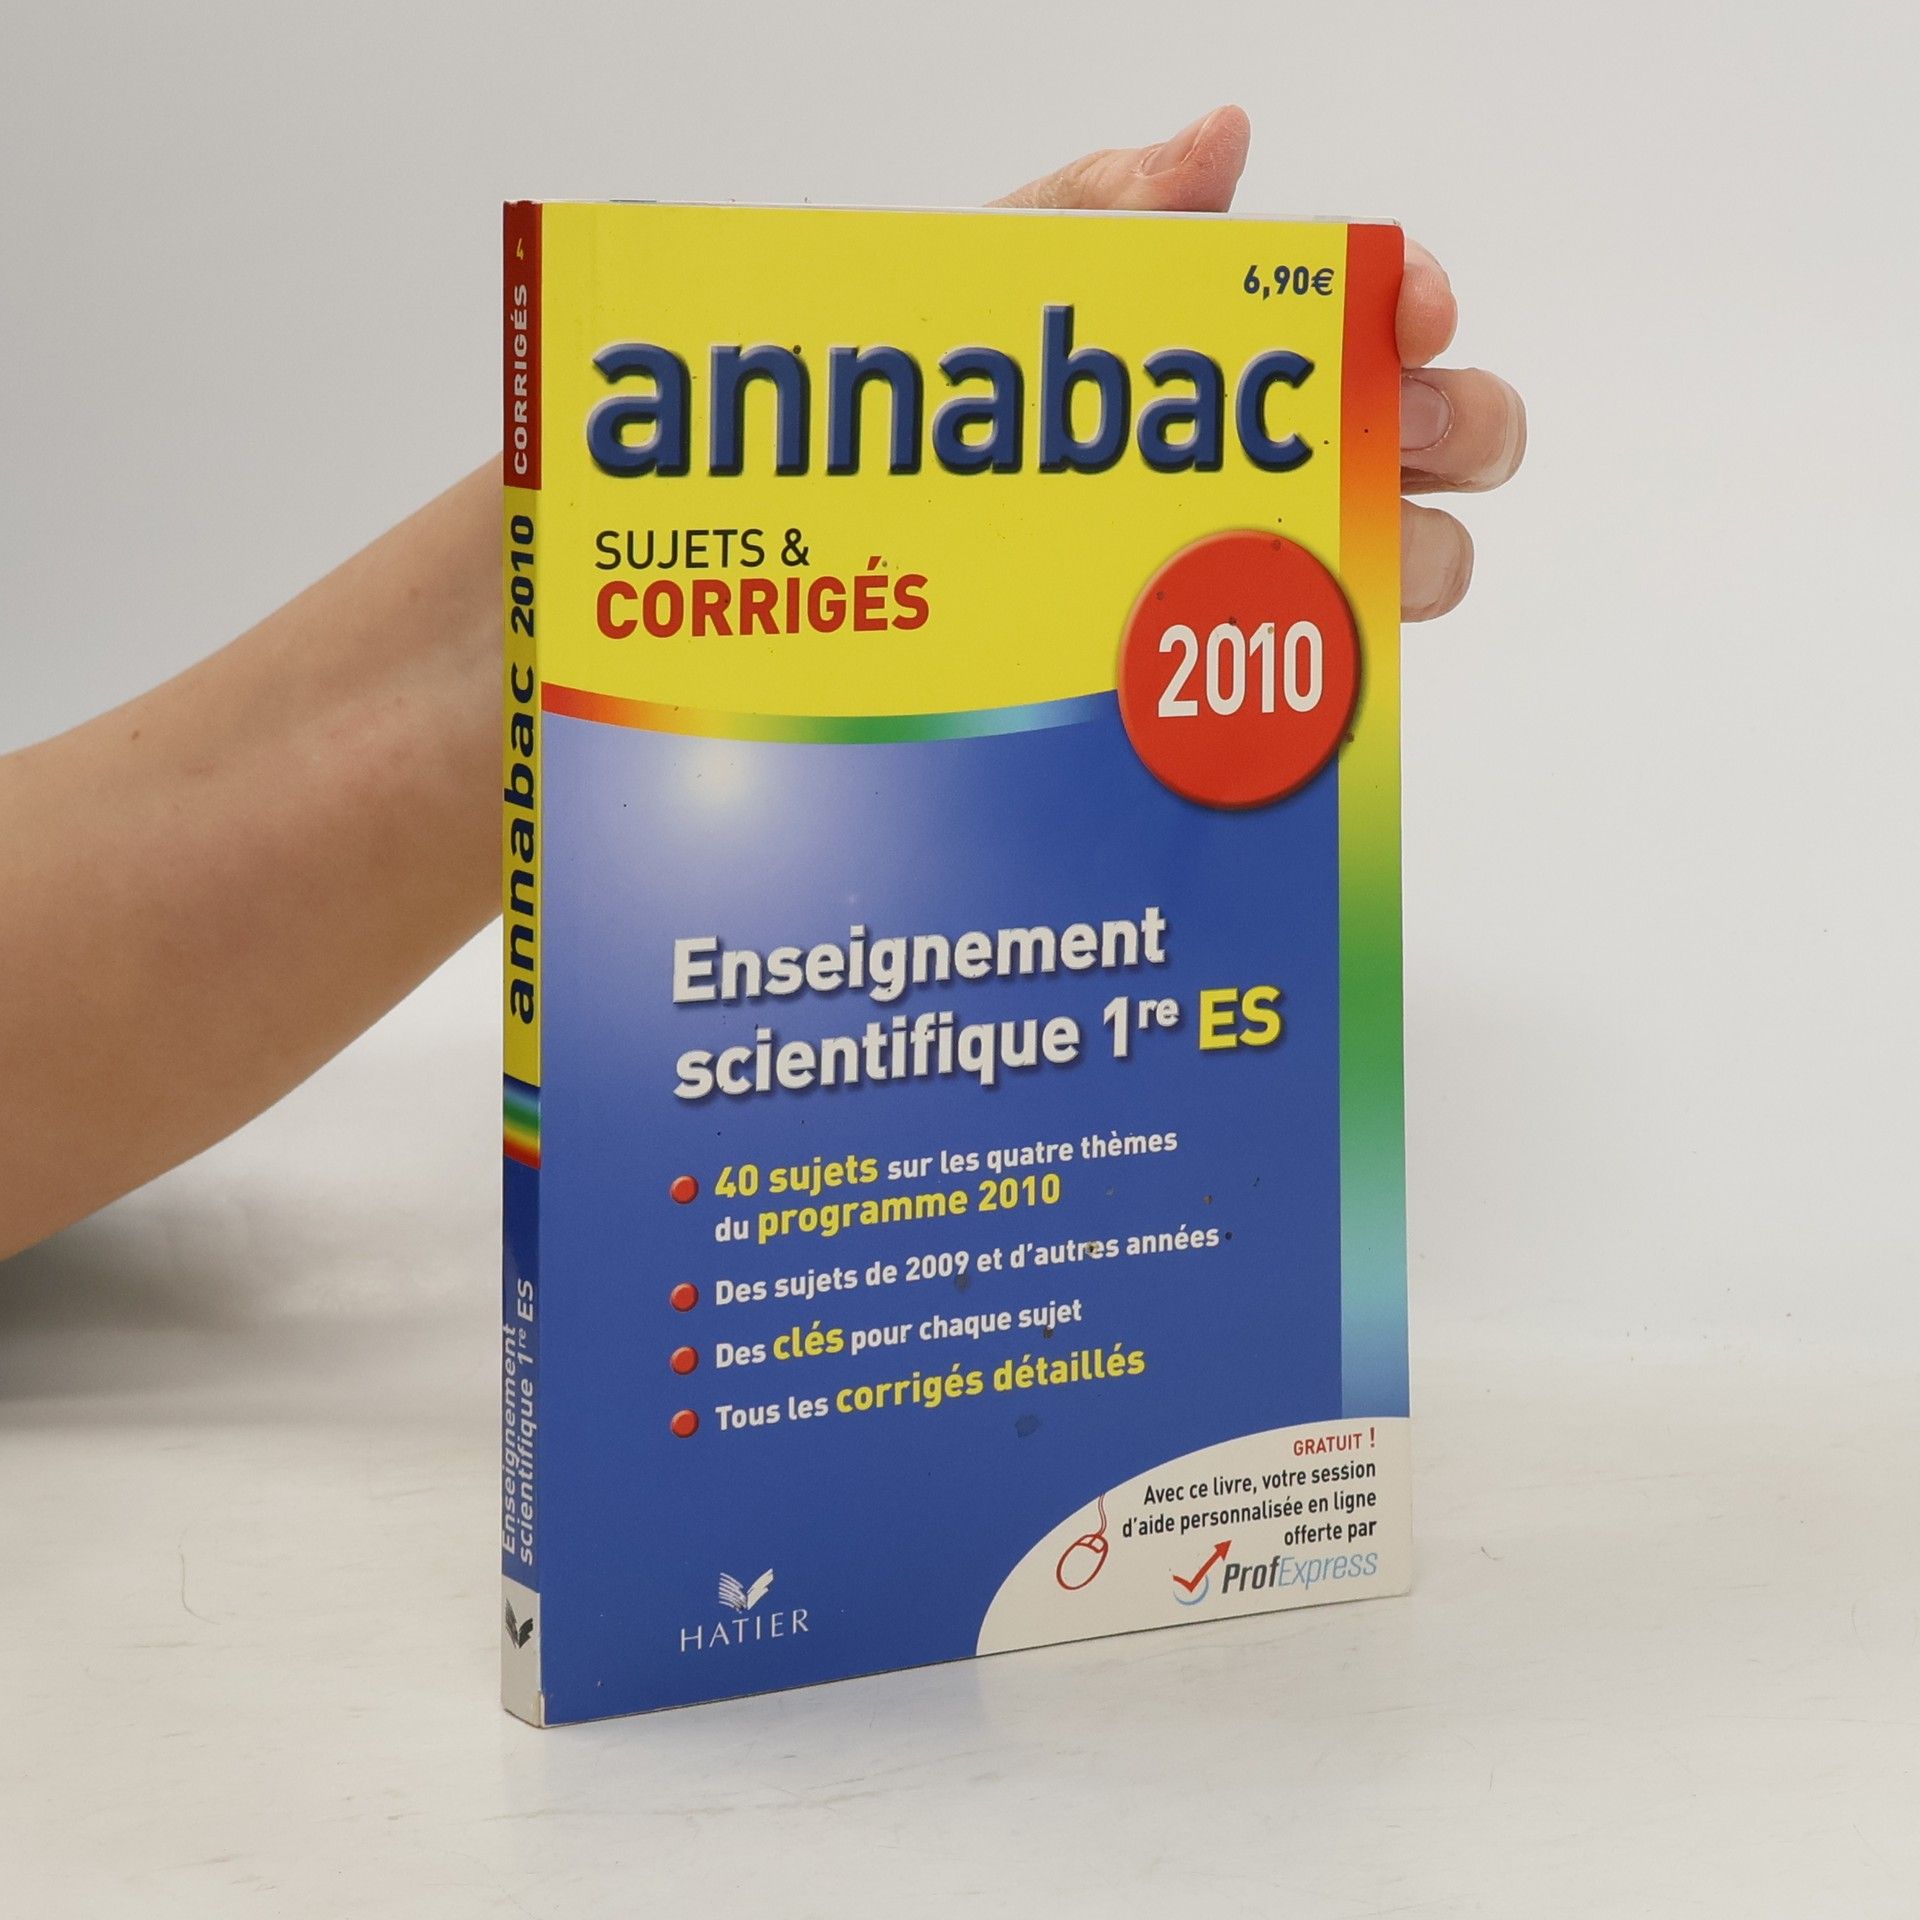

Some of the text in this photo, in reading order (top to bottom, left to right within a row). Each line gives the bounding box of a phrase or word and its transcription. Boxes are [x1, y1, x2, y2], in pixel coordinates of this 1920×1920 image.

[1243, 264, 1335, 300] 6,90€
[510, 283, 528, 475] CORRIGÉS
[587, 304, 1315, 478] annabac
[594, 527, 810, 570] SUJETS &
[595, 556, 931, 640] CORRIGÉS
[1157, 620, 1324, 718] 2010
[503, 514, 535, 1025] annabac 2010
[672, 906, 1167, 1004] Enseignement
[672, 1010, 1080, 1100] scientifique
[1198, 984, 1282, 1051] ES
[714, 1130, 1178, 1199] 40 sujets sur les quatre thèmes
[714, 1172, 1062, 1245] du programme 2010
[517, 1278, 534, 1322] ES
[715, 1280, 767, 1306] Des
[774, 1268, 858, 1301] sujets
[864, 1260, 898, 1287] de
[905, 1250, 970, 1282] 2009
[976, 1248, 1003, 1273] et
[1126, 1223, 1220, 1256] années
[715, 1299, 1082, 1369] Des clés pour chaque sujet
[715, 1342, 1146, 1432] Tous les corrigés détaillés
[502, 1323, 518, 1555] Enseignement
[516, 1378, 537, 1567] scientifique
[1293, 1426, 1376, 1456] GRATUIT !
[1143, 1460, 1377, 1505] Avec ce livre, votre session
[1180, 1496, 1303, 1535] personnalisée
[1308, 1496, 1329, 1513] en
[1333, 1491, 1377, 1515] ligne
[1284, 1519, 1378, 1546] offerte par
[1221, 1552, 1379, 1594] ProfExpress
[679, 1608, 810, 1653] HATIER
